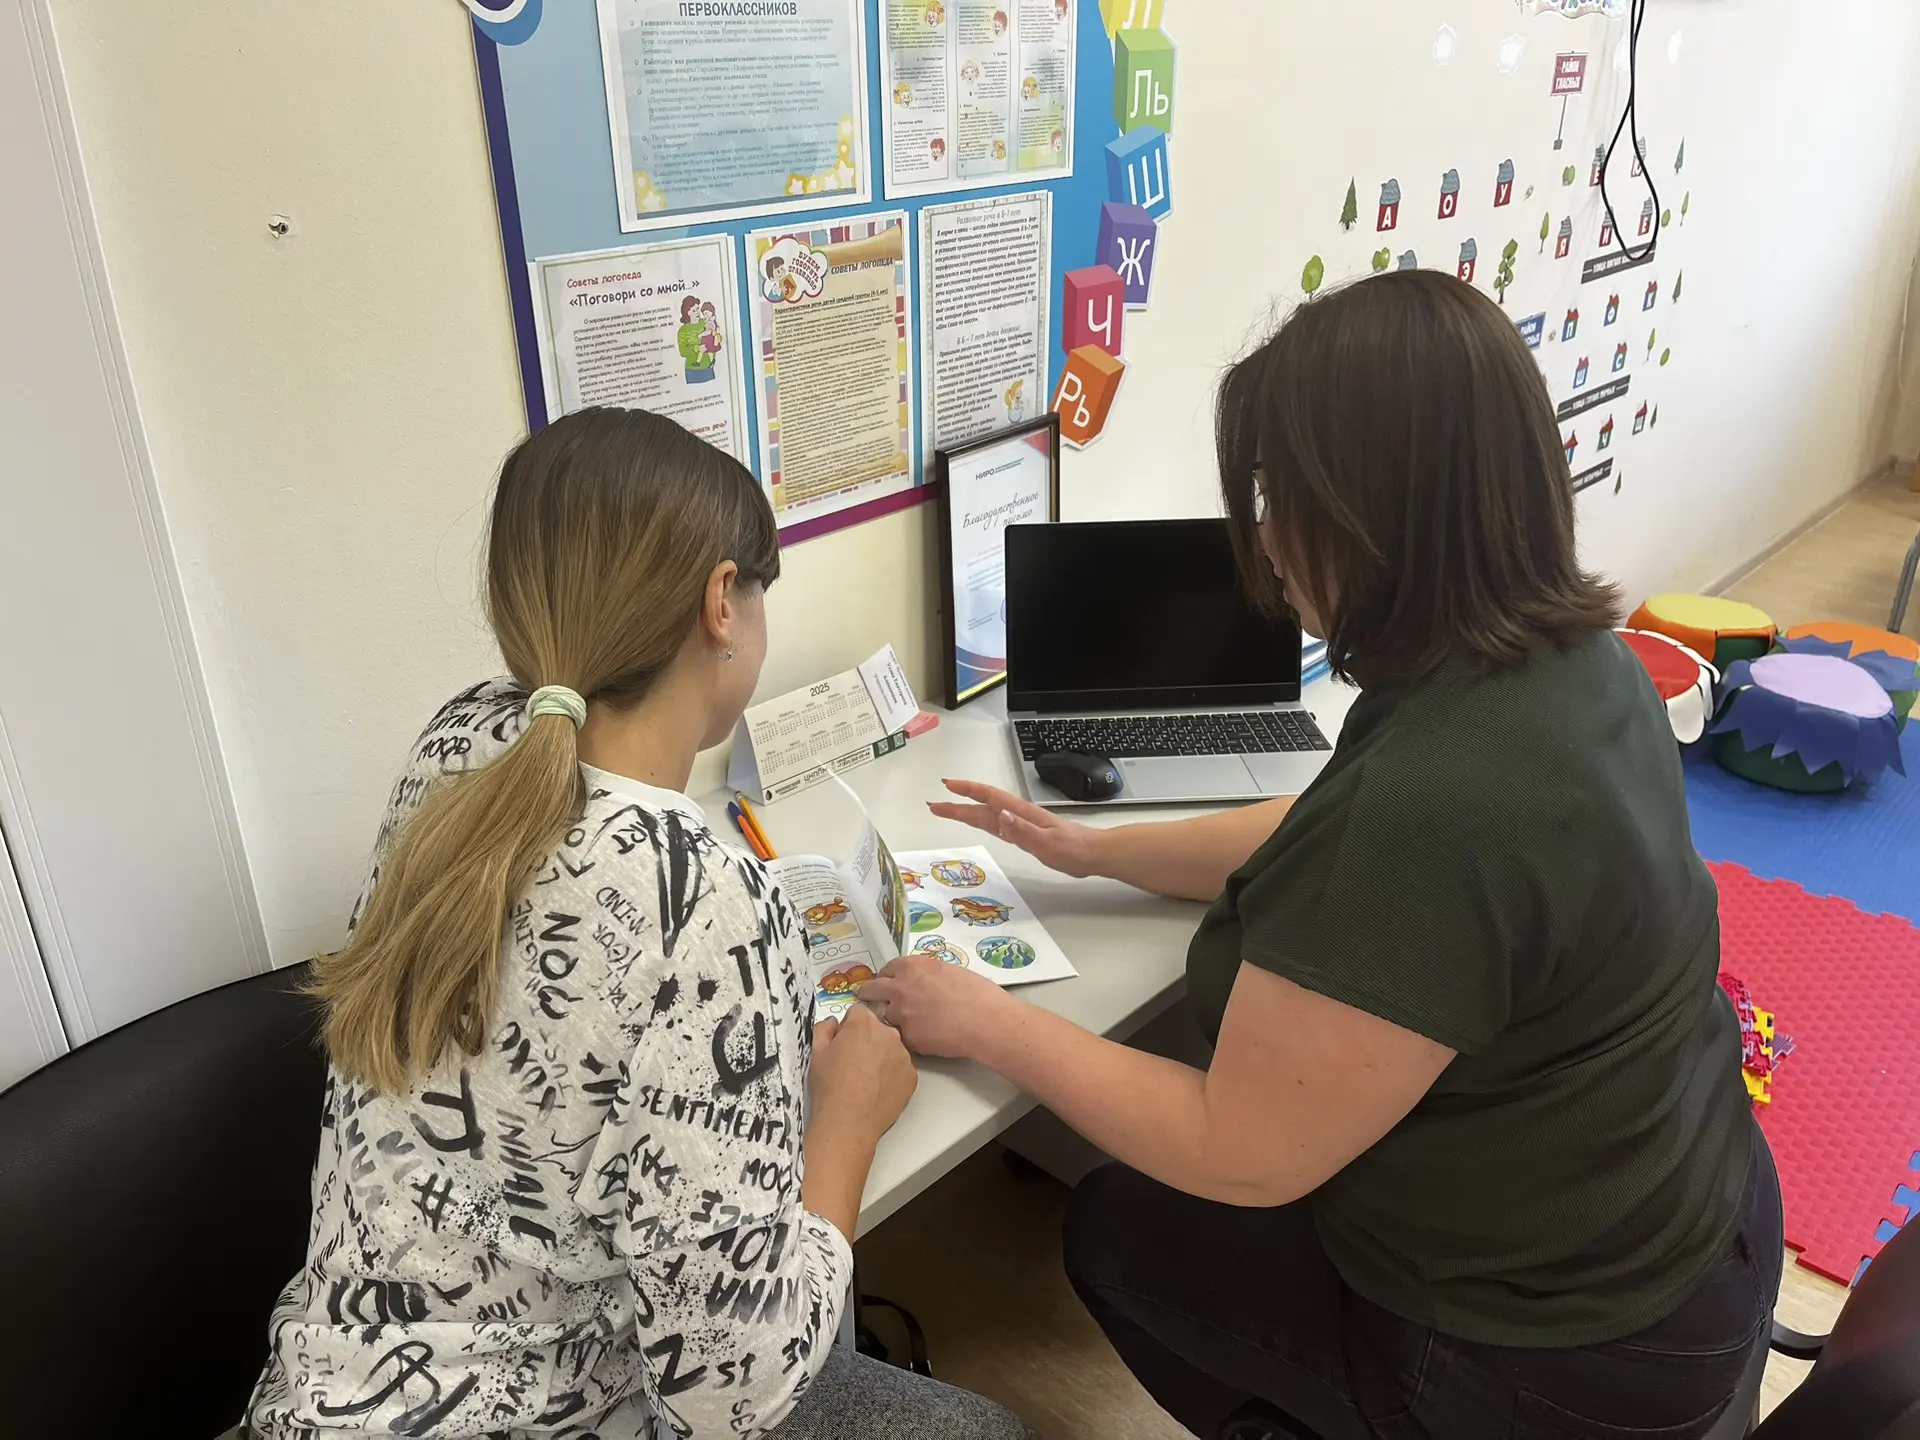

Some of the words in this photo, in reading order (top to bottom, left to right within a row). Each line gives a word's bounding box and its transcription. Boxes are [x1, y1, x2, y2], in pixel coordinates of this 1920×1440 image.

[679, 1, 796, 17] ПЕРВОКЛАССНИКОВ
[1129, 69, 1169, 119] Ль
[1128, 148, 1164, 210] Ш
[1500, 183, 1509, 204] У
[1443, 194, 1453, 215] О
[1382, 206, 1392, 228] А
[792, 258, 820, 283] ГОВОРИТЬ
[798, 251, 821, 272] БУДЕМ
[831, 264, 858, 275] СОВЕТЫ
[860, 258, 893, 270] ЛОГОПЕДА
[1117, 237, 1151, 286] Ж
[566, 275, 598, 288] Советы
[601, 269, 641, 283] логопеда
[788, 265, 817, 291] ПРАВИЛЬНО
[569, 290, 636, 308] «Поговори
[640, 287, 652, 297] со
[1088, 294, 1113, 346] Ч
[1566, 321, 1574, 338] П
[1616, 353, 1623, 369] С
[1054, 371, 1091, 428] Рь
[975, 468, 994, 480] НИРО
[962, 492, 1039, 531] Благодарственное
[810, 683, 830, 697] 2025
